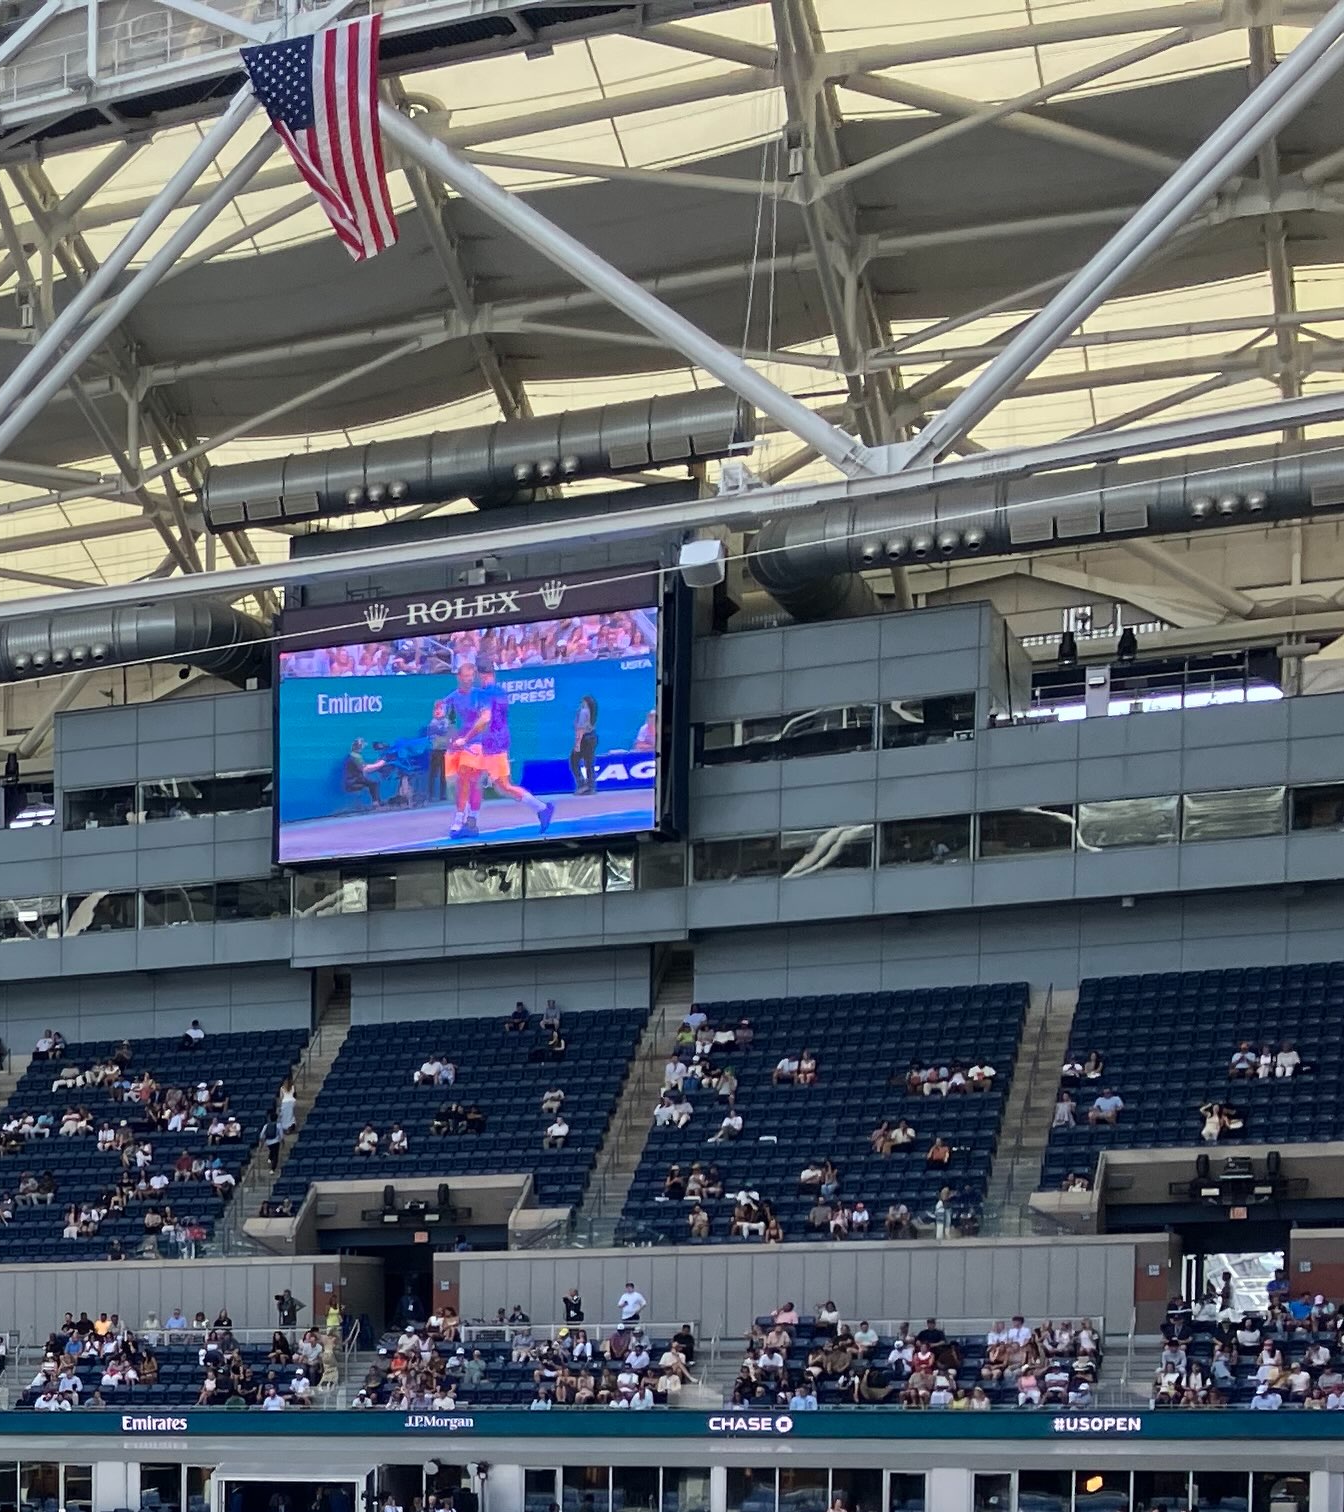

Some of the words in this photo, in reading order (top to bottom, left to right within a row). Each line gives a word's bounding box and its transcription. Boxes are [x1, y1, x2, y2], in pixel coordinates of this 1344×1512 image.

[406, 591, 520, 626] ROLEX
[497, 677, 555, 692] MERICAN
[317, 694, 383, 715] Emirates
[580, 760, 655, 782] AG
[122, 1416, 188, 1431] Emirates
[404, 1415, 474, 1431] J.P.Morgan
[708, 1417, 773, 1431] CHASE
[1054, 1417, 1141, 1431] #USOPEN
